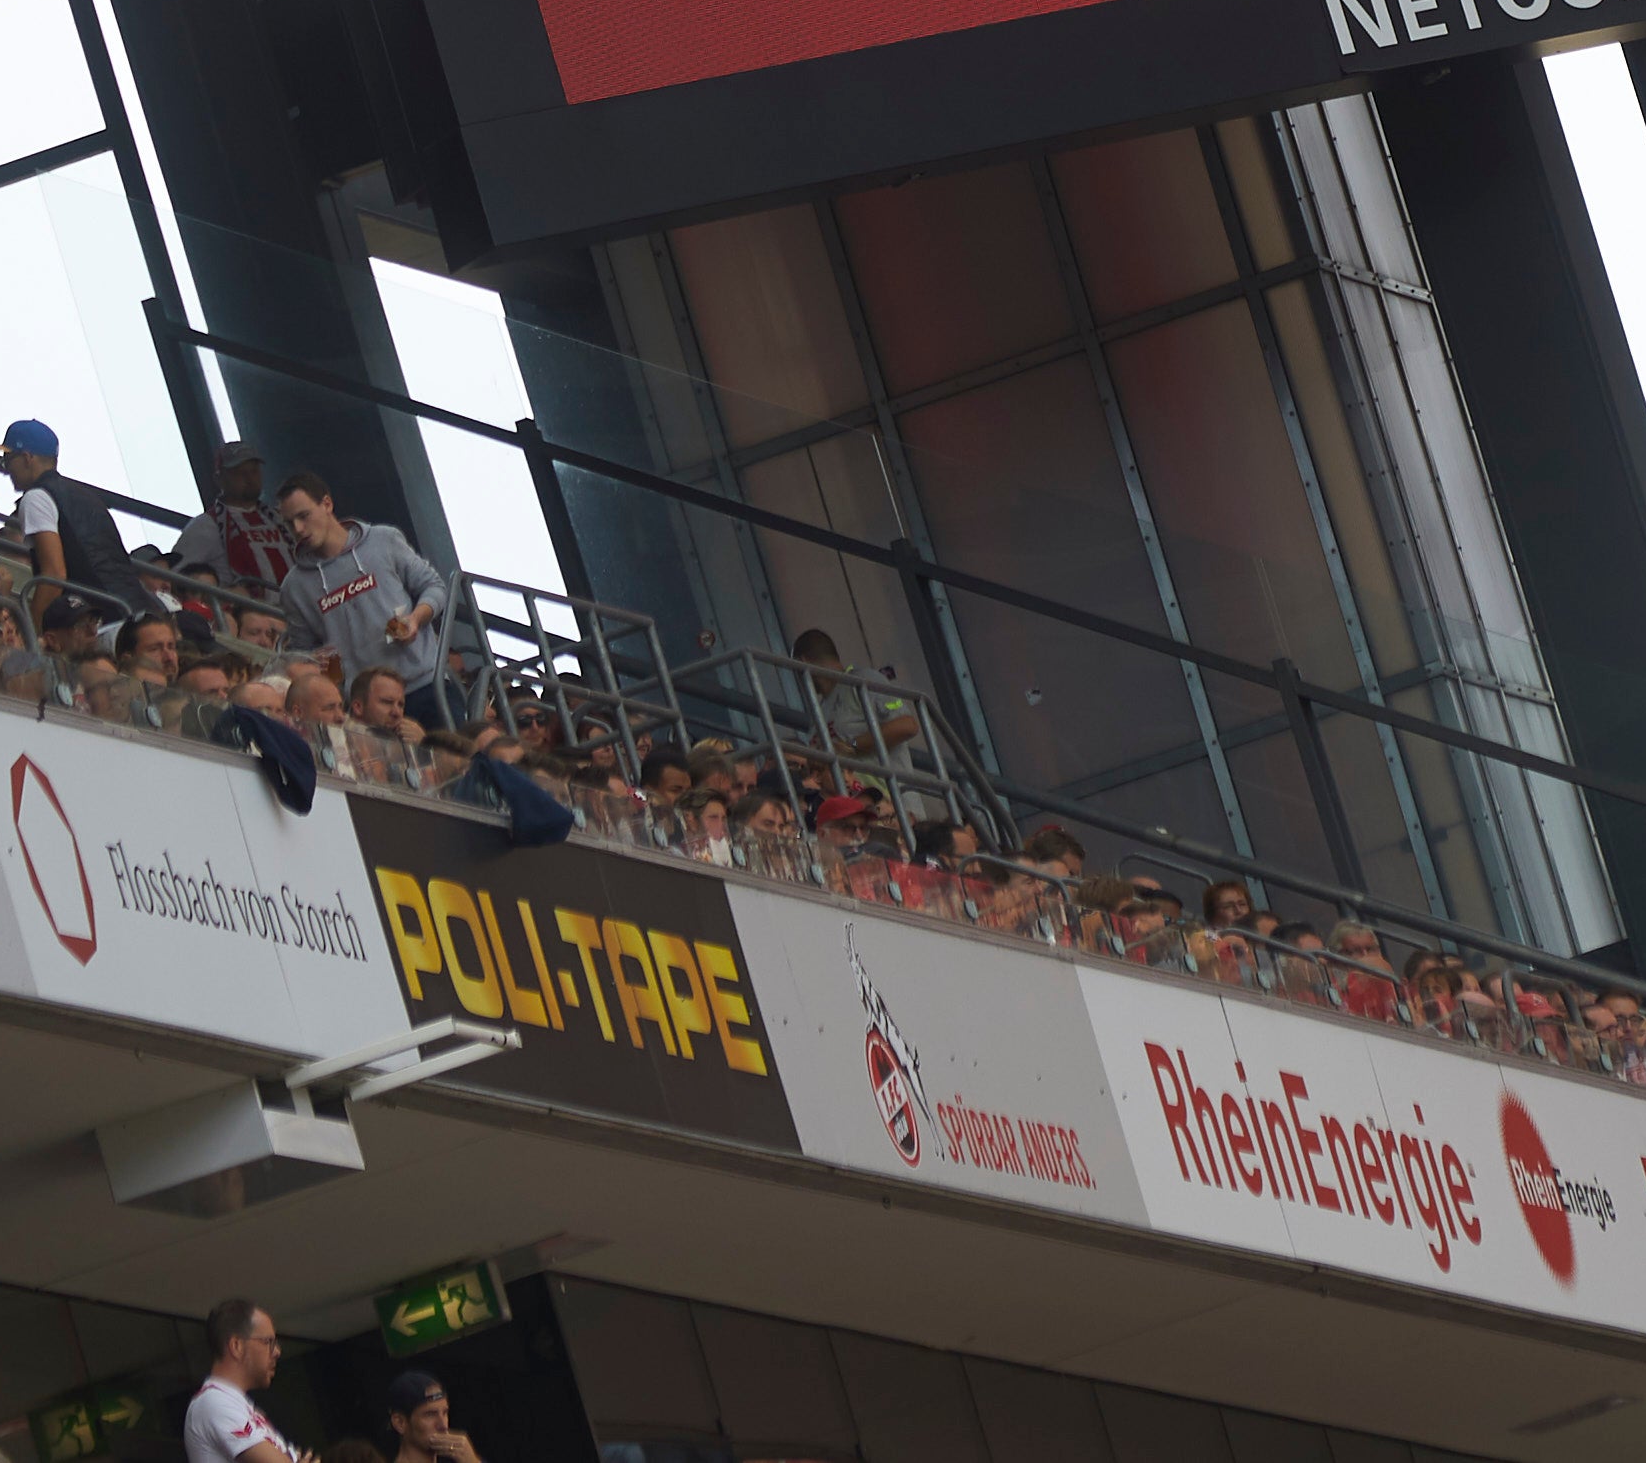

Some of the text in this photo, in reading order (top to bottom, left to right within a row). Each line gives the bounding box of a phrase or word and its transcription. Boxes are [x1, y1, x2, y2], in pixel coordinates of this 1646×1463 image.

[320, 575, 374, 611] Stay Cool
[105, 839, 369, 963] Flossbach von Storch
[937, 1092, 1027, 1178] SPÜRBAR
[1017, 1118, 1098, 1191] ANDERS.
[1143, 1040, 1484, 1273] RheinEnergie
[1511, 1156, 1618, 1232] RheinEnergie
